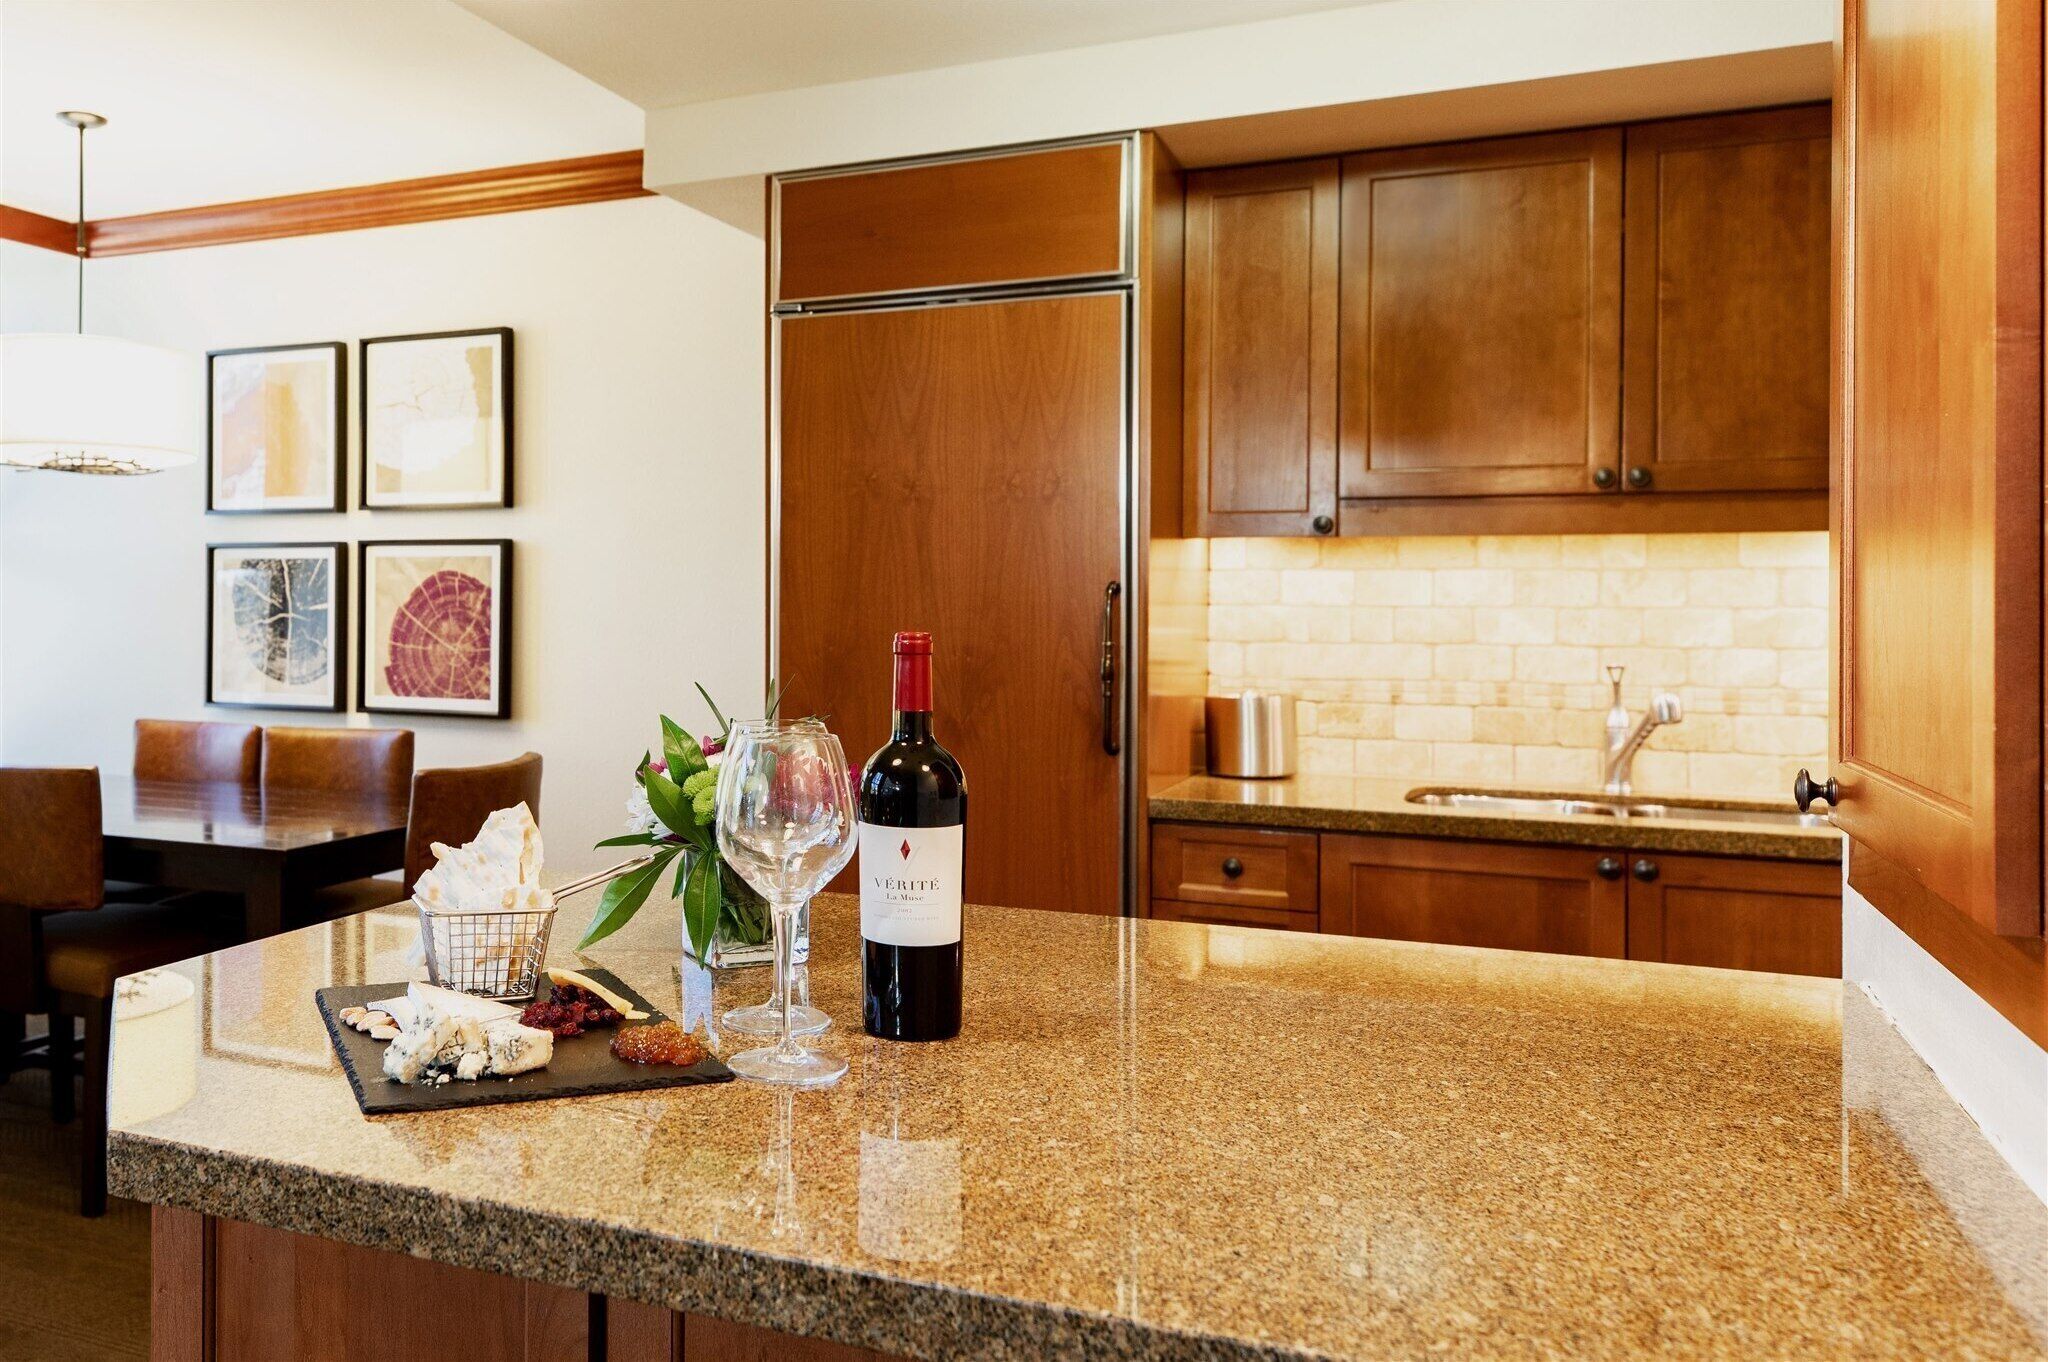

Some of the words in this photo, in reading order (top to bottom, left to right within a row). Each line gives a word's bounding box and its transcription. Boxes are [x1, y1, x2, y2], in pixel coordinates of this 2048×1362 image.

[874, 876, 940, 891] VÉRITÉ
[885, 892, 897, 901] La
[900, 893, 924, 902] Muse
